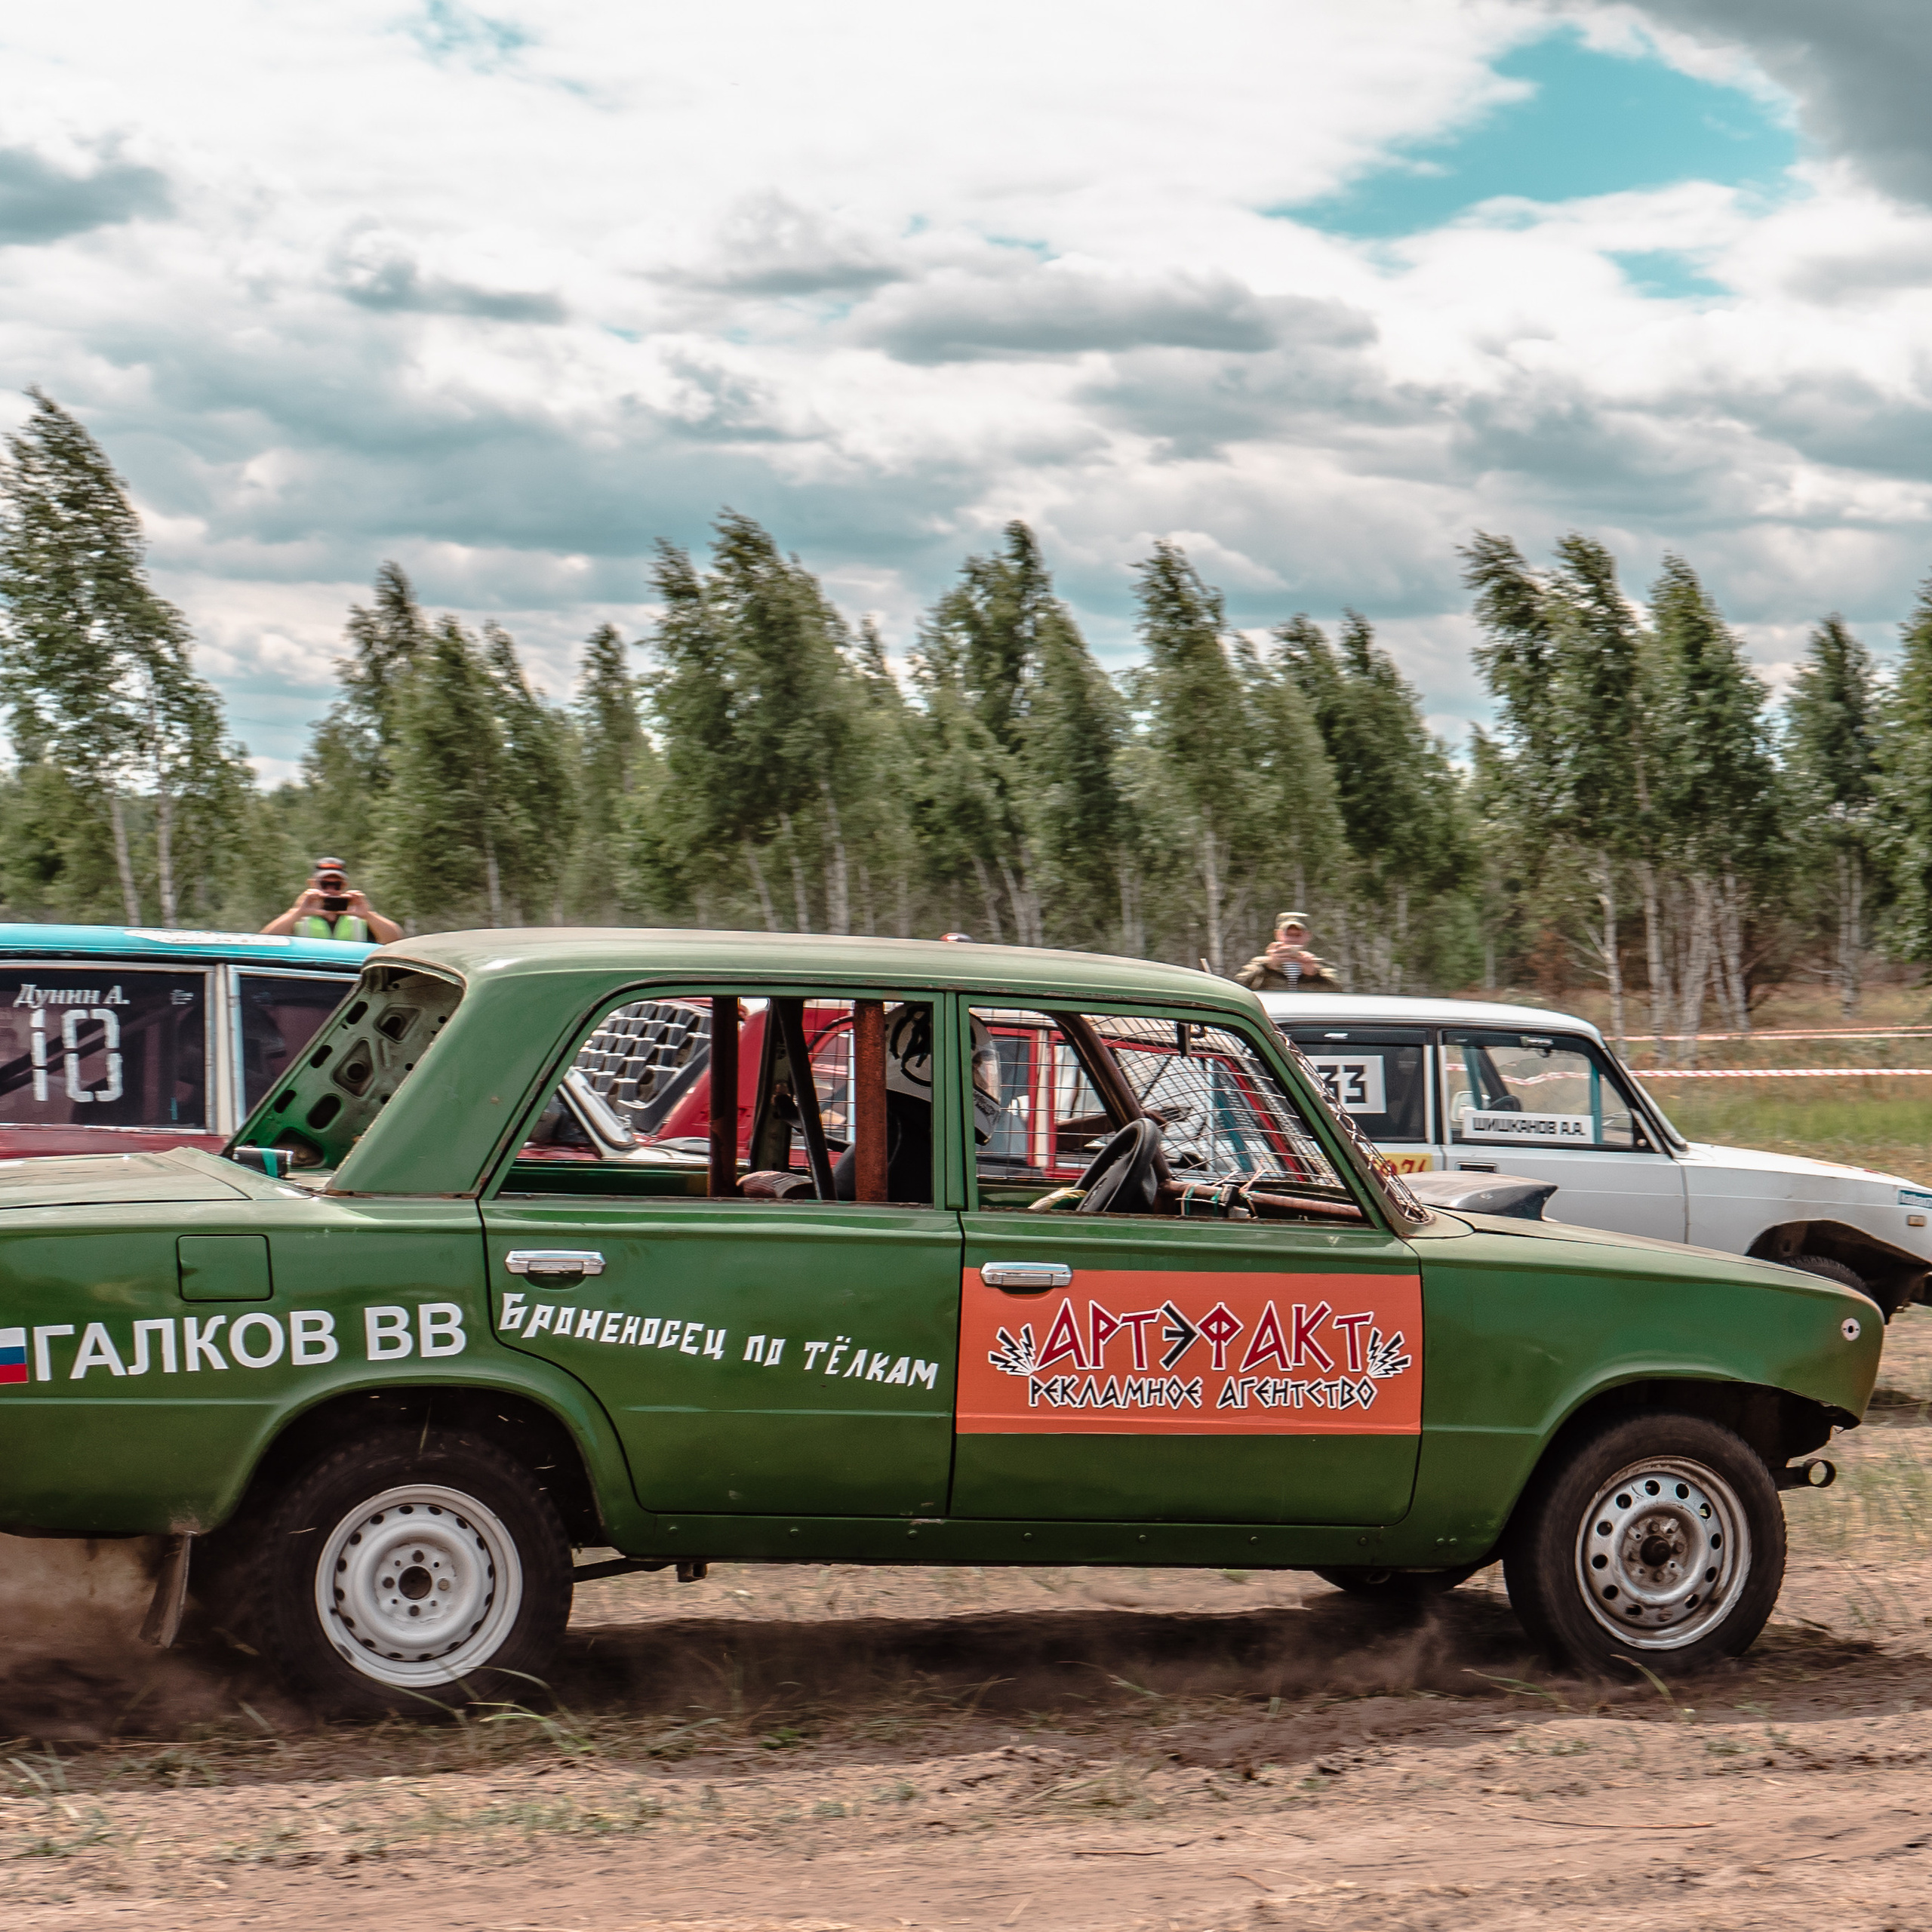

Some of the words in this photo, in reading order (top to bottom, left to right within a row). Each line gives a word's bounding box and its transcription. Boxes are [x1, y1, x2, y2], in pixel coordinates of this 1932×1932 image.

[13, 984, 100, 1008] Дунин
[103, 985, 131, 1004] А.
[30, 1008, 123, 1102] 10
[1316, 1065, 1367, 1103] 33
[33, 1310, 339, 1381] ГАЛКОВ
[365, 1303, 466, 1361] ВВ
[1035, 1297, 1374, 1373] АРТЭФАКТ
[1029, 1375, 1202, 1409] РЕКЛАМНОЕ
[1216, 1375, 1378, 1410] АГЕНТСТВО
